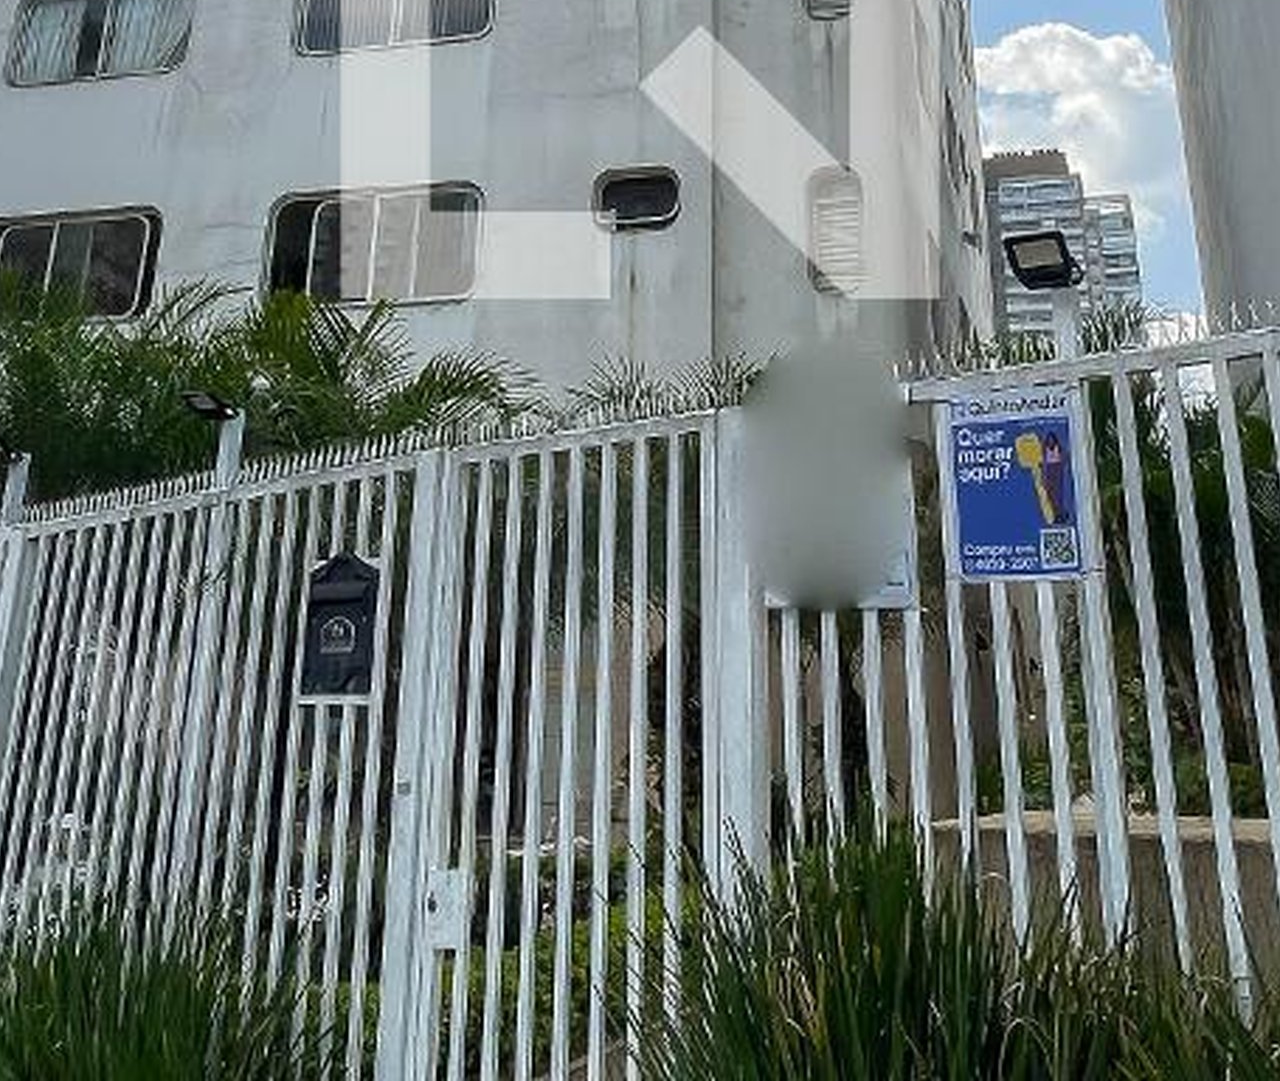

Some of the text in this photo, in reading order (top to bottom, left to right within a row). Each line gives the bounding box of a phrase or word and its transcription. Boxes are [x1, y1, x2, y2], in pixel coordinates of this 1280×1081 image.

[958, 428, 1005, 447] Quer
[958, 448, 1013, 463] morar
[959, 462, 1011, 484] aqui?
